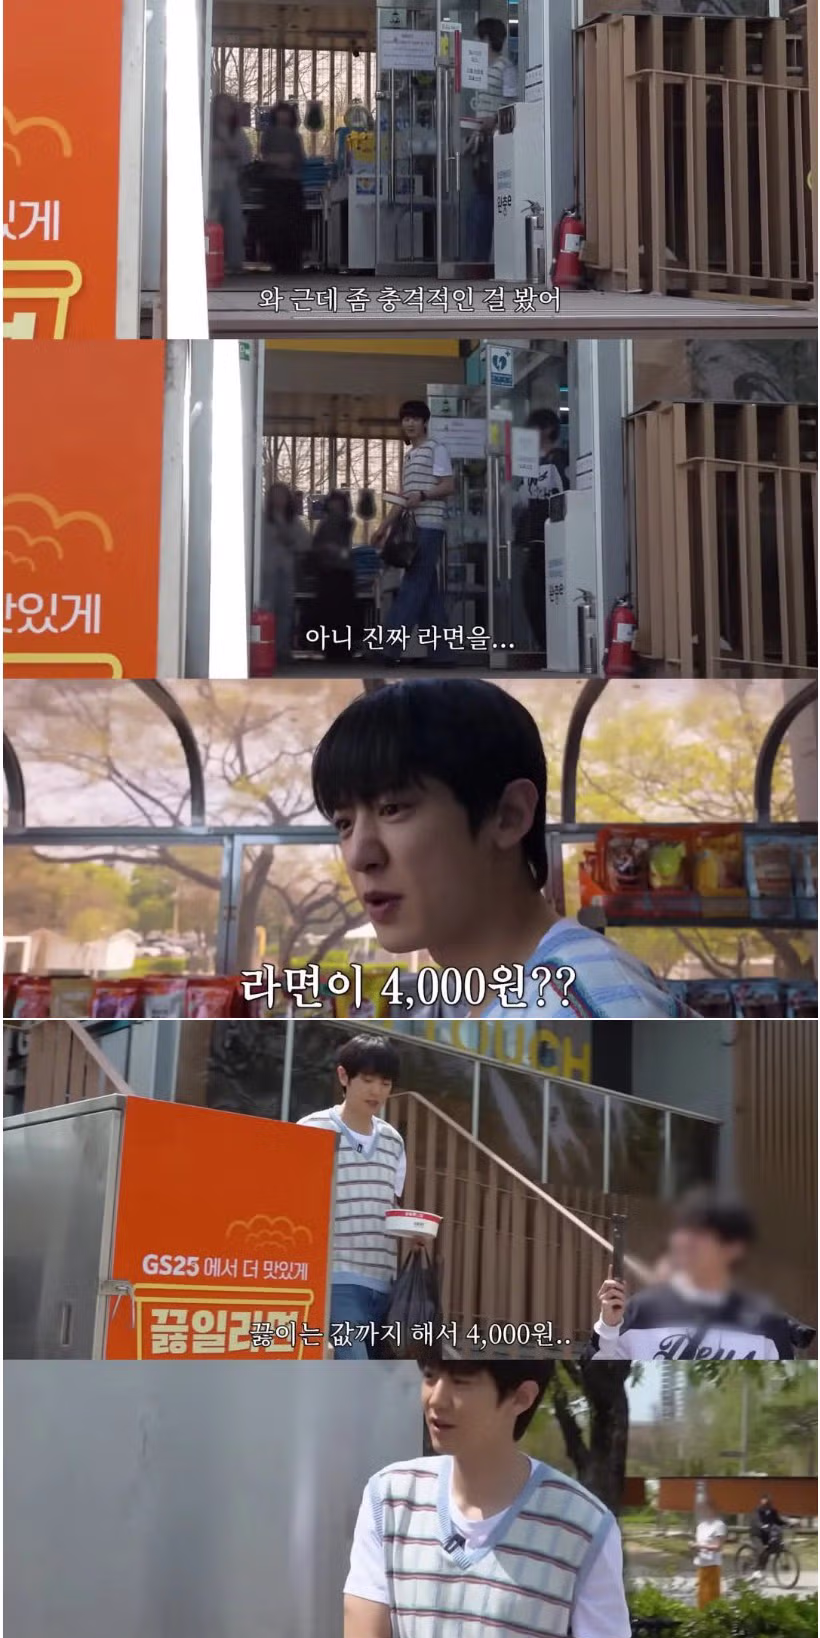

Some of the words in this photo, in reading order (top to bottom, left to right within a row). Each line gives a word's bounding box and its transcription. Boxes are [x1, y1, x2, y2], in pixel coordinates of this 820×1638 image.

[142, 1254, 200, 1277] GS25
[203, 1257, 238, 1278] 에서
[242, 1259, 259, 1279] 더
[263, 1260, 309, 1281] 맛있게
